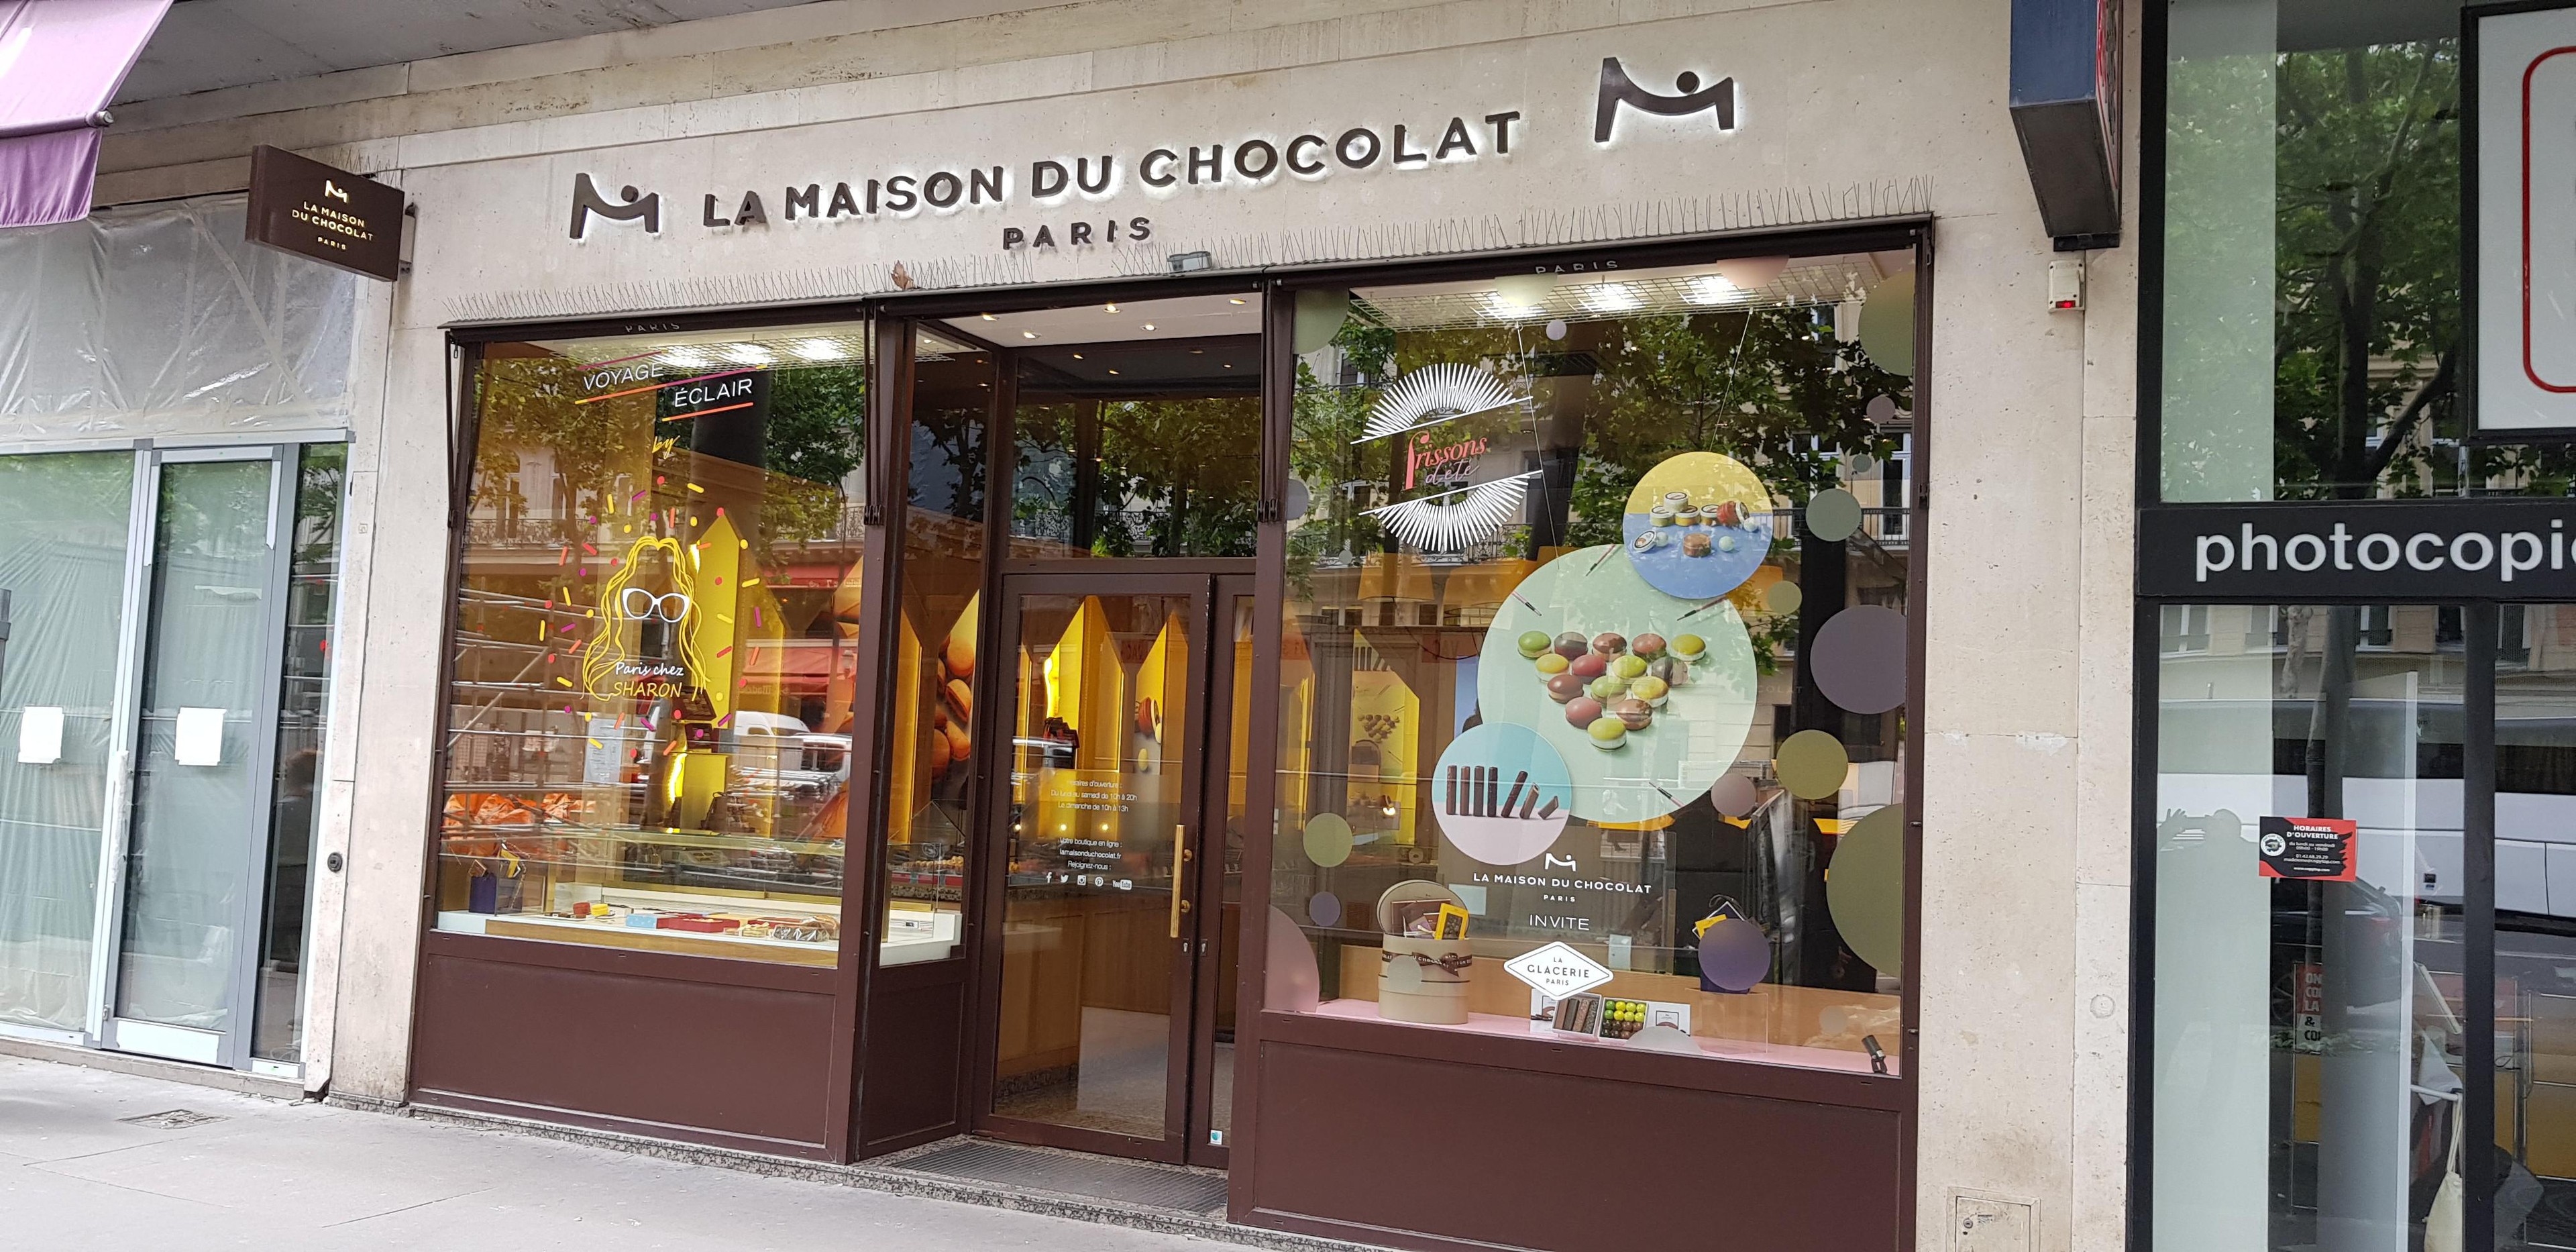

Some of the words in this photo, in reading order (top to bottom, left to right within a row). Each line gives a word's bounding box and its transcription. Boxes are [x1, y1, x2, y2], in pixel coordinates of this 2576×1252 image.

[703, 191, 767, 227] LA
[785, 165, 1004, 221] MAISON
[1032, 155, 1114, 199] DU
[1140, 111, 1520, 187] CHOCOLAT
[303, 201, 318, 213] LA
[321, 207, 365, 227] MAISON
[292, 209, 308, 221] DU
[312, 216, 373, 241] CHOCOLAT
[1003, 216, 1150, 250] PARIS
[317, 236, 347, 250] PARIS
[1536, 260, 1617, 274] PARIS
[583, 362, 664, 390] VOYAGE
[674, 378, 753, 407] ÉCLAIR
[652, 435, 680, 459] by
[1405, 430, 1487, 490] frissons
[2196, 518, 2576, 582] photocopi
[615, 662, 651, 676] Paris
[653, 662, 684, 676] chez
[614, 680, 683, 698] SHARON
[1074, 838, 1097, 847] boutique
[1060, 848, 1122, 859] lamaisonduchocolat.fr
[1068, 860, 1108, 870] Rejoignez-nous
[1473, 873, 1489, 882] LA
[1494, 874, 1546, 886] MAISON
[1552, 878, 1570, 888] DU
[1574, 880, 1652, 894] CHOCOLAT
[1529, 914, 1590, 931] INVITE
[1527, 964, 1590, 978] GLACERIE
